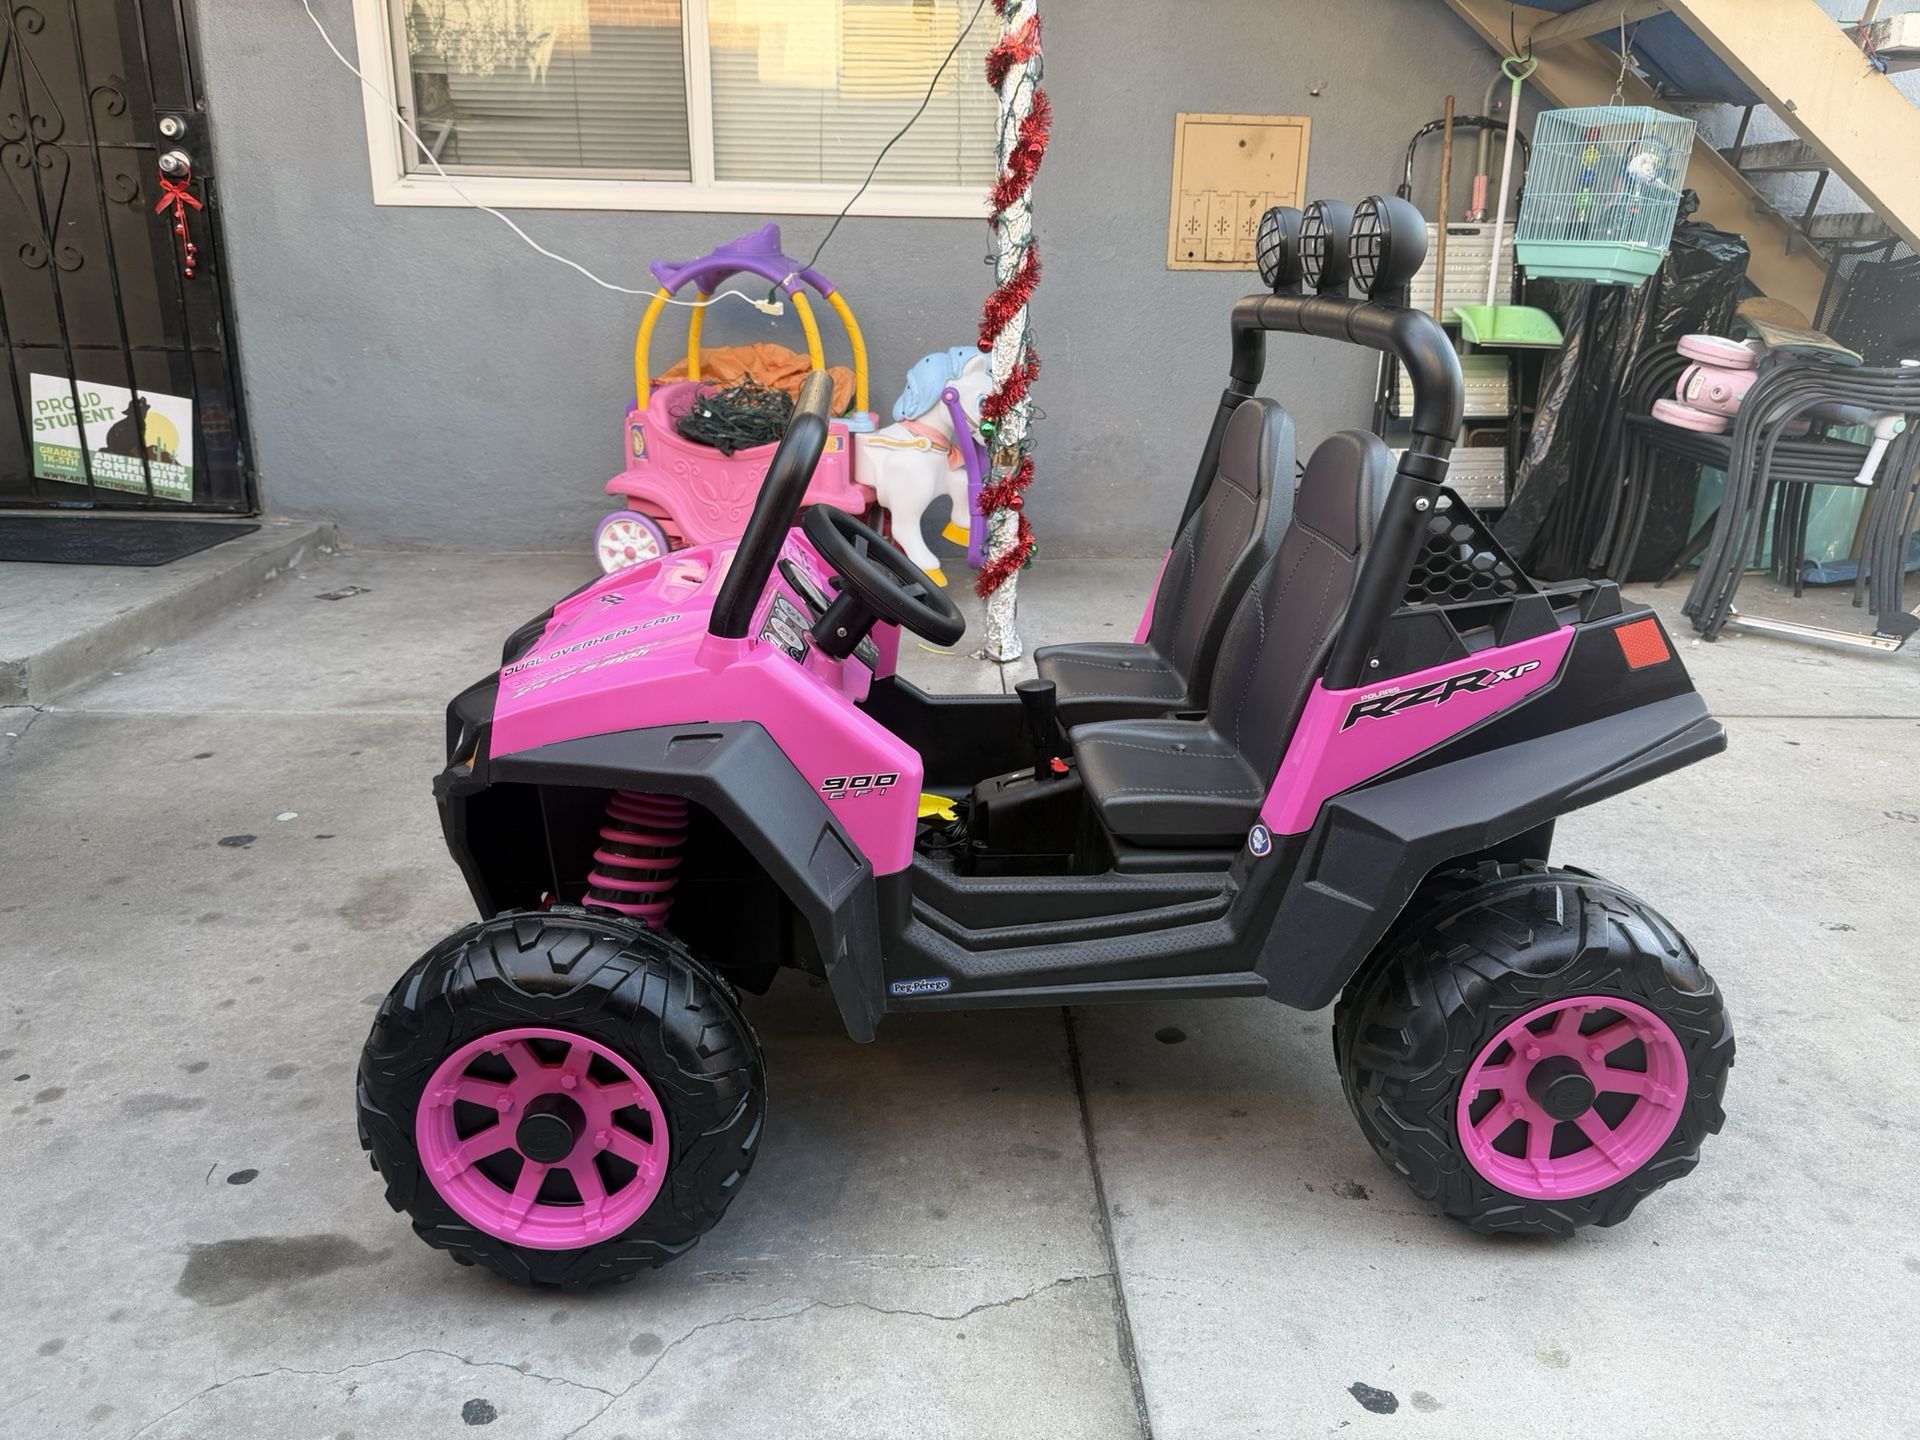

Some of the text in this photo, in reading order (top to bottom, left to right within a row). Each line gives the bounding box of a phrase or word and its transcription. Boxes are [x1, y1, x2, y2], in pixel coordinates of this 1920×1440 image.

[36, 392, 102, 415] PROUD
[39, 446, 80, 458] GRADES
[94, 452, 126, 463] ARTS
[148, 459, 186, 473] CTION
[151, 477, 190, 491] CHOOL
[504, 614, 681, 676] DUAL OVERHEAD CAM
[1339, 660, 1542, 734] RZR XP
[1360, 686, 1400, 702] POLARIS
[820, 772, 900, 792] 900
